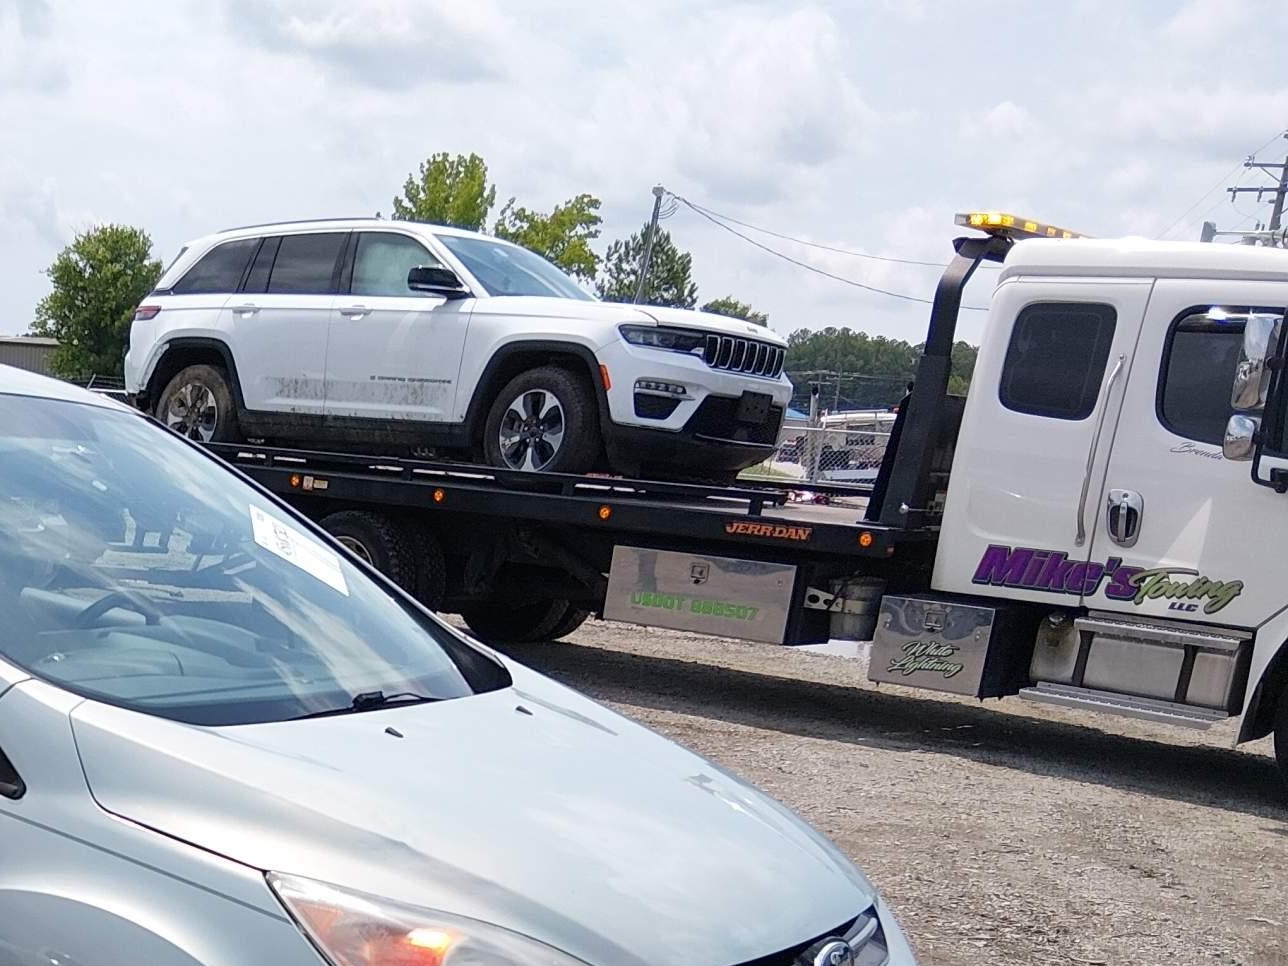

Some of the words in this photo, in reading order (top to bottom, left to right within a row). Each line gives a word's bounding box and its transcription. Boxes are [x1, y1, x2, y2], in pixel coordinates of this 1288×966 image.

[971, 544, 1145, 601] Mike's
[1128, 567, 1244, 614] Towing
[1167, 602, 1198, 612] LLC
[901, 640, 961, 658] White
[886, 655, 964, 679] Lightning
